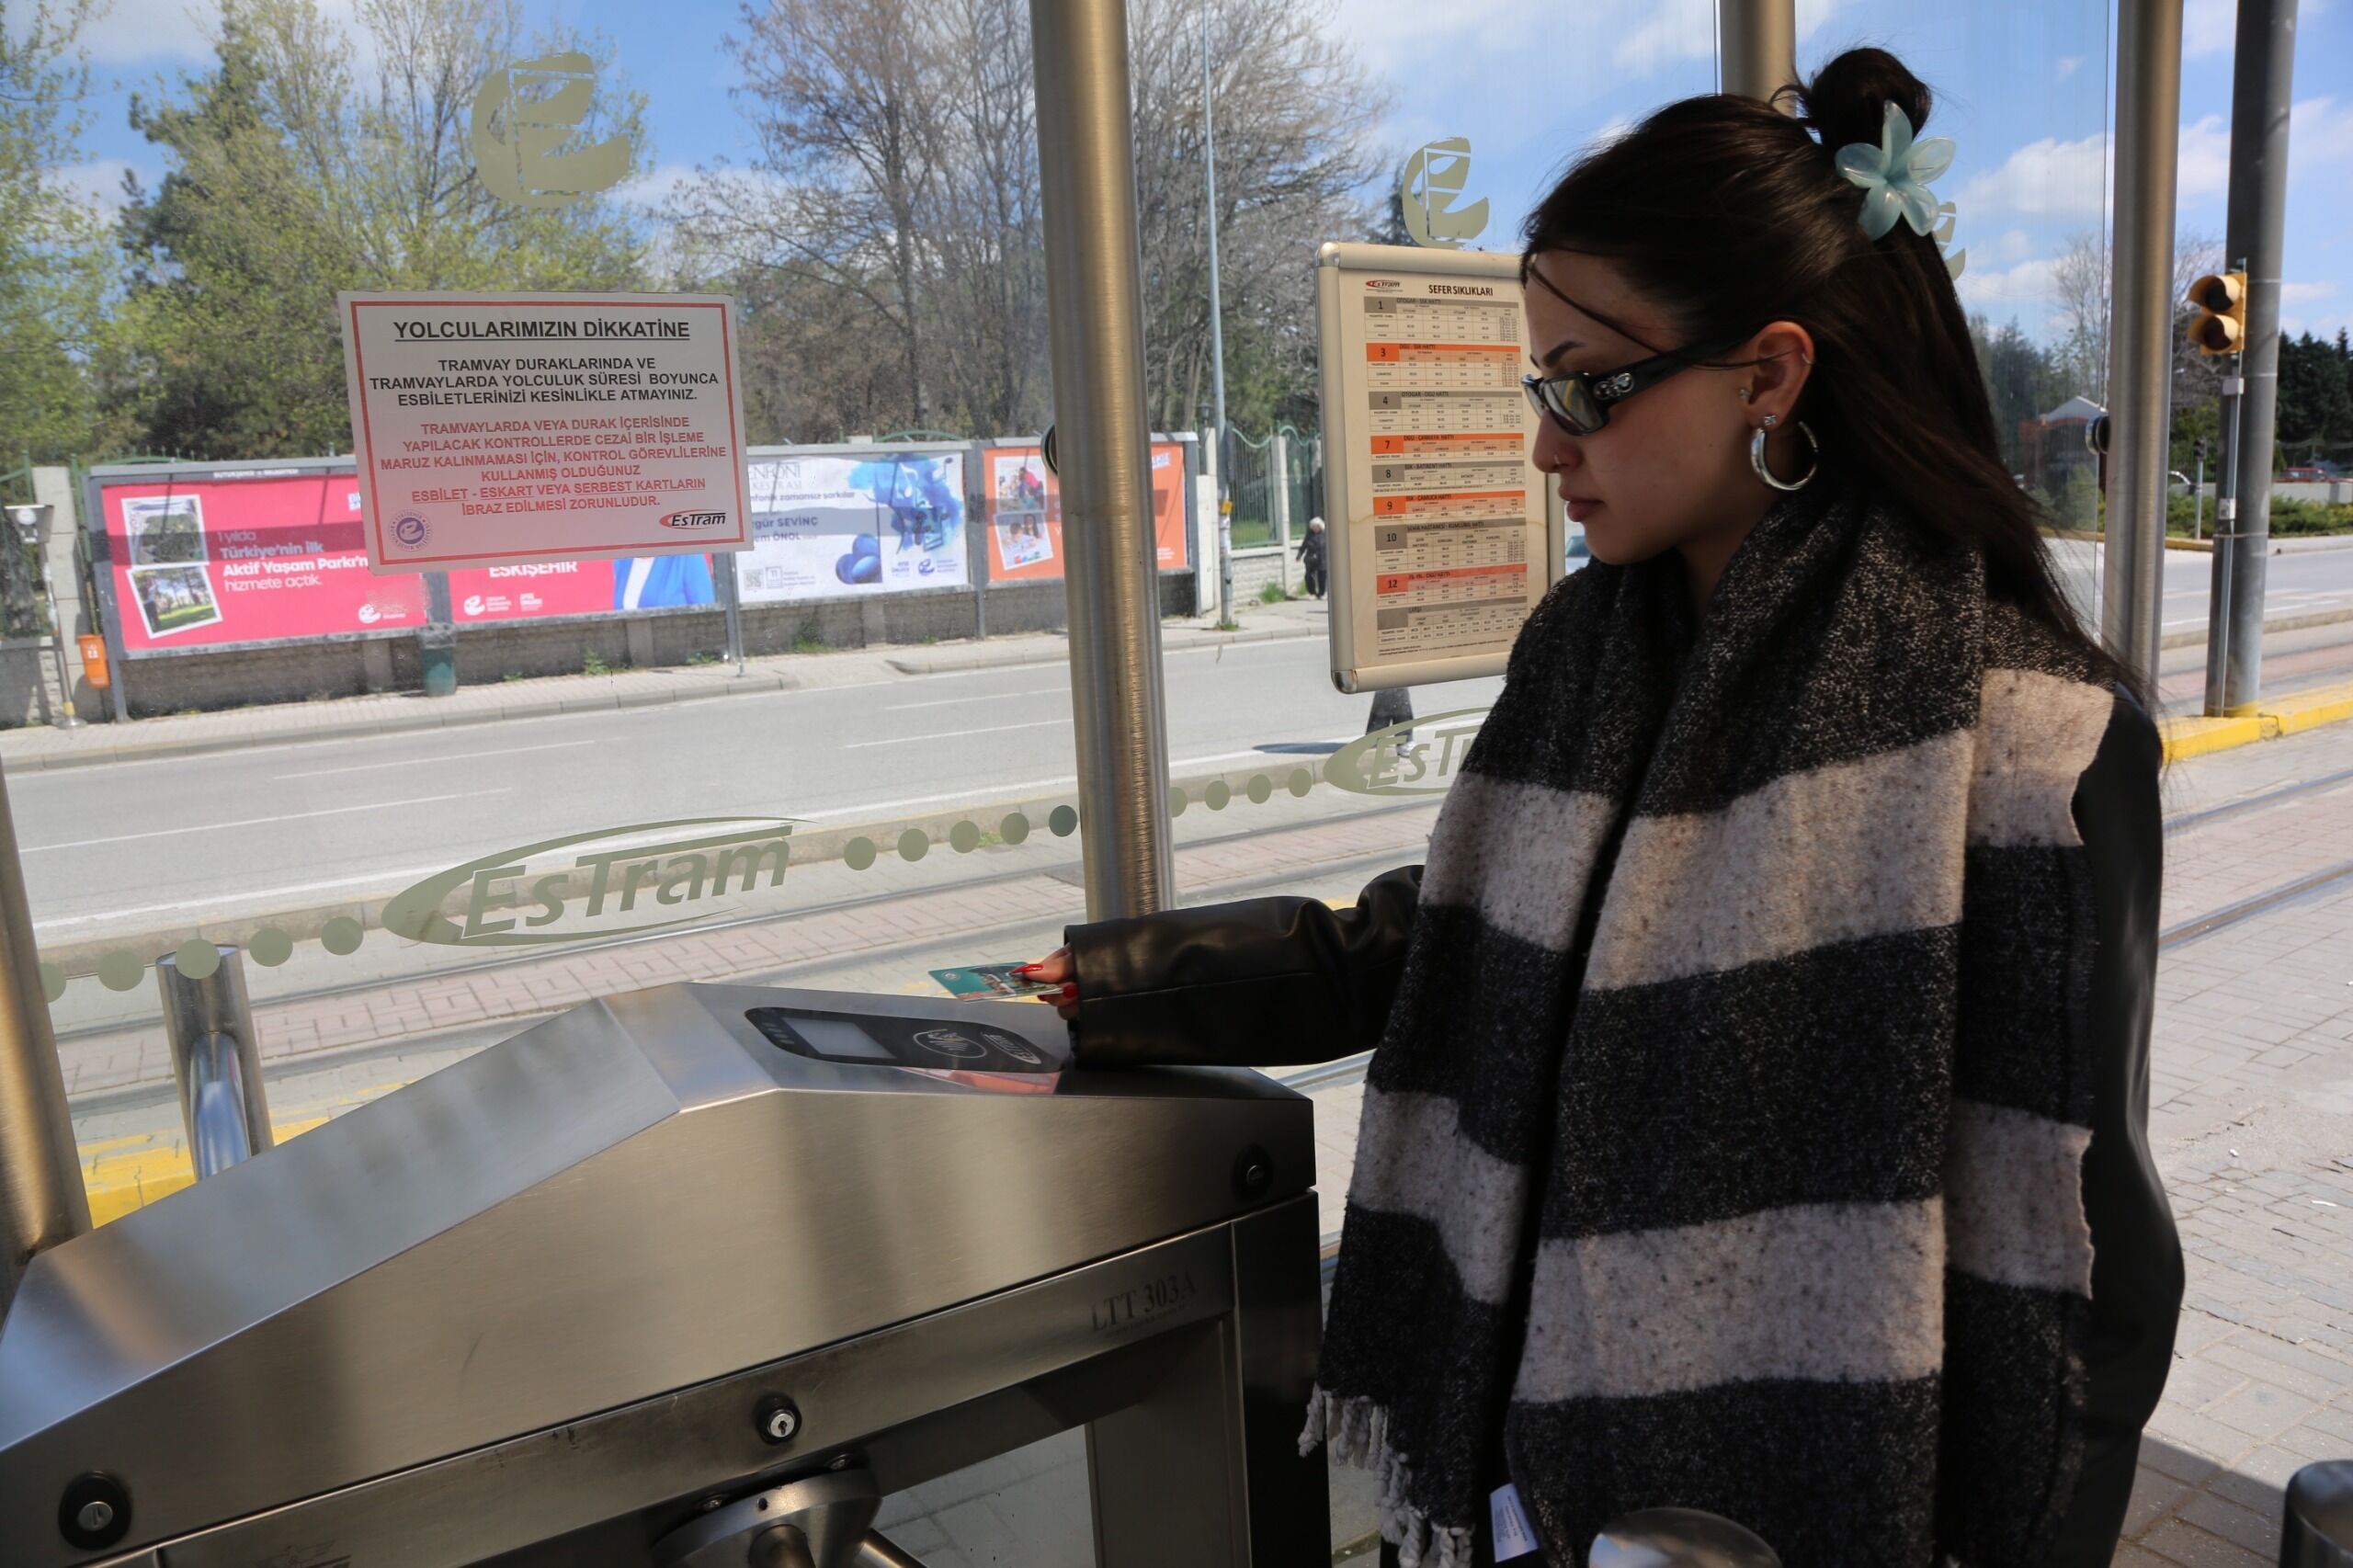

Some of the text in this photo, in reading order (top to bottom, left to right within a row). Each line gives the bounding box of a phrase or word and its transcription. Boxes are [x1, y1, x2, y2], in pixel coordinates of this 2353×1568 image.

[1428, 285, 1494, 296] SEFER SIKLIKLARI
[1378, 301, 1383, 310] 1
[394, 319, 689, 338] YOLCULARIMIZIN DİKKATİNE
[1381, 348, 1386, 358] 3
[438, 358, 655, 372] TRAMVAY DURAKLARINDA VE
[369, 370, 718, 390] TRAMVAYLARDA YOLCULUK SÜRESİ BOYUNCA
[398, 388, 697, 406] ESBİLETLERİNİZİ KESİNLİKLE ATMAYINIZ.
[1382, 396, 1388, 405] 4
[421, 415, 689, 434] TRAMVAYLARDA VEYA DURAK İÇERİSİNDE
[403, 430, 704, 451] YAPILACAK KONTROLLERDE CEZAİ BİR İŞLEME
[1385, 440, 1390, 449] 7
[381, 445, 726, 470] MARUZ KALINMAMASI İÇİN, KONTROL GÖREVLİLERİNE
[482, 463, 640, 483] KULLANMIŞ OLDUĞUNUZ
[1386, 470, 1392, 478] 8
[412, 488, 467, 503] ESBİLET
[480, 485, 532, 498] ESKART
[537, 483, 569, 495] VEYA
[574, 481, 631, 494] SERBEST
[637, 478, 705, 491] KARTLARIN
[462, 494, 660, 516] İBRAZ EDİLMESİ ZORUNLUDUR.
[1387, 502, 1392, 510] 9
[671, 512, 726, 527] EsTram
[777, 515, 818, 528] SEVİNÇ
[224, 530, 256, 542] yılda
[1387, 533, 1397, 542] 10
[220, 540, 324, 559] Türkiye'nin ilk
[223, 562, 260, 576] Aktif
[263, 559, 315, 574] Yaşam
[225, 577, 281, 592] hizmete
[1388, 580, 1398, 588] 12
[461, 824, 793, 938] EsTram
